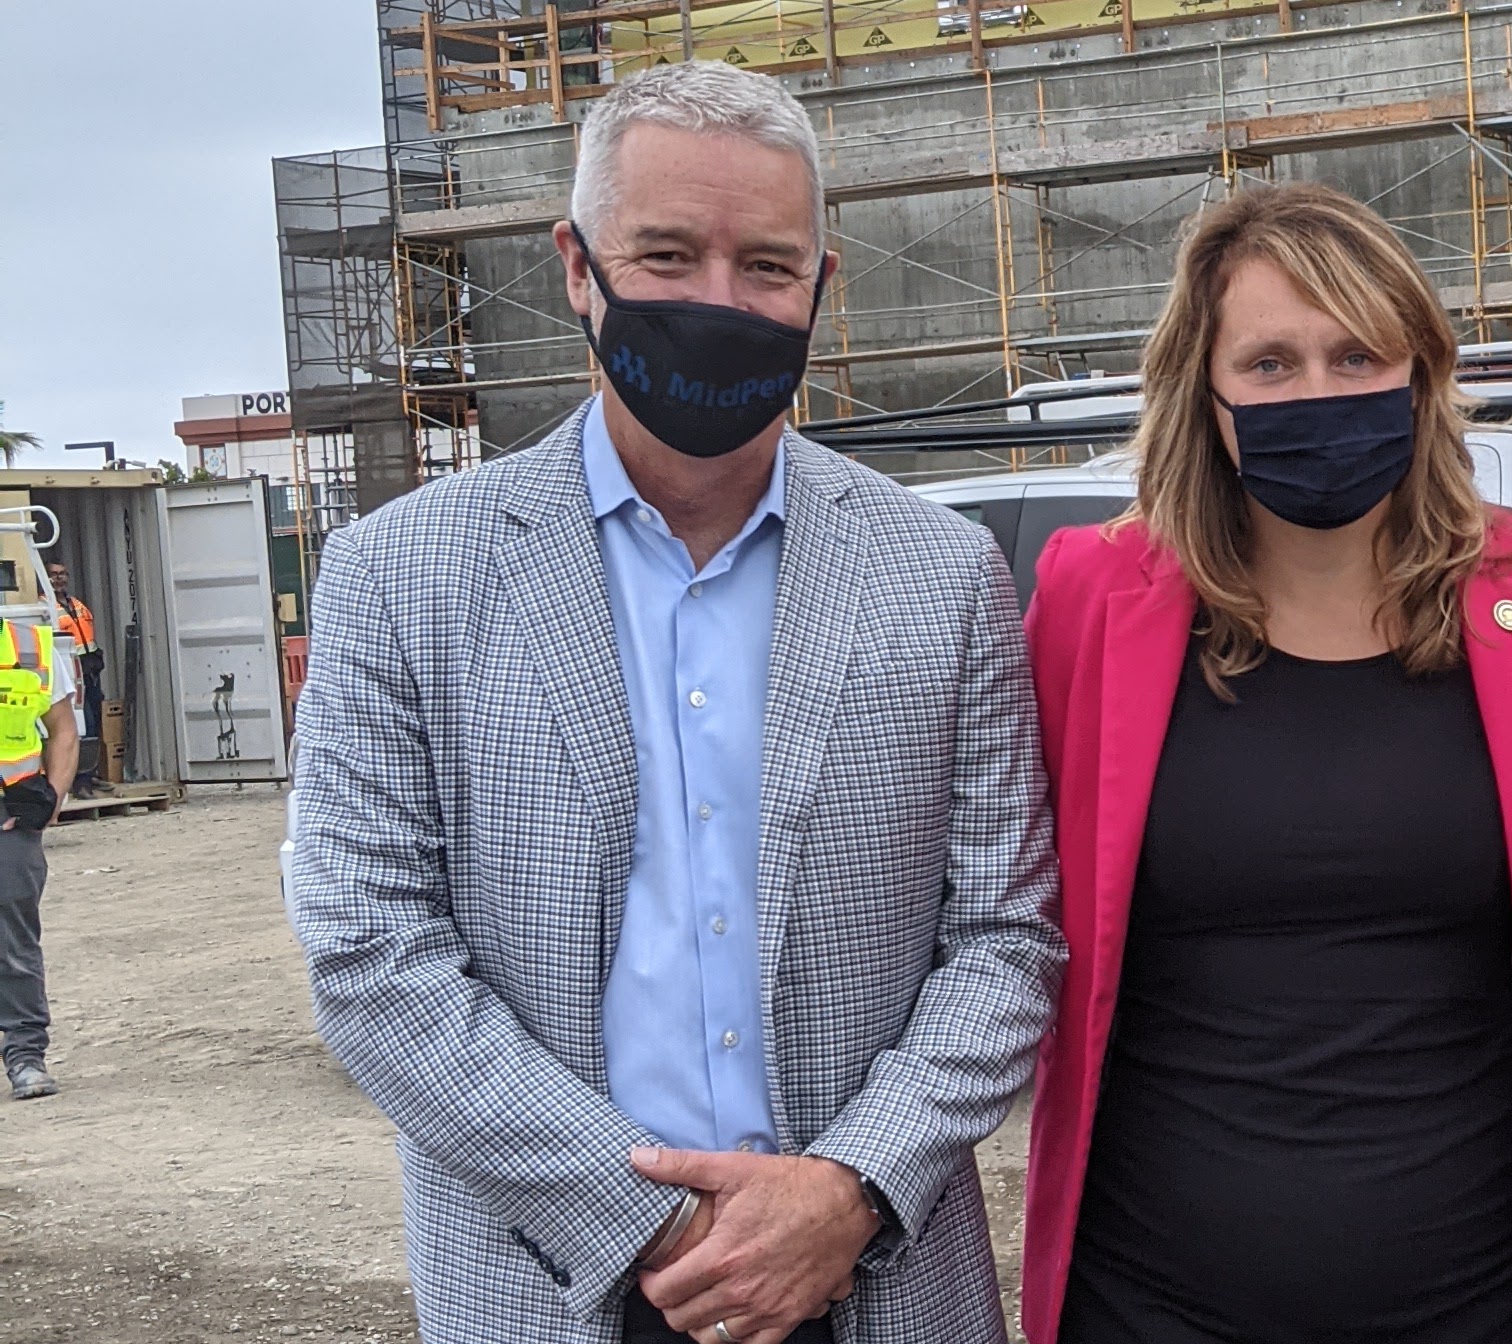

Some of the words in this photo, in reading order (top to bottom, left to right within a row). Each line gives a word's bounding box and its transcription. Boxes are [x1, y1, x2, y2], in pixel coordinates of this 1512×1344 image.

[868, 34, 885, 44] GP
[794, 44, 810, 55] GP
[726, 53, 741, 64] GP
[242, 392, 289, 415] POR
